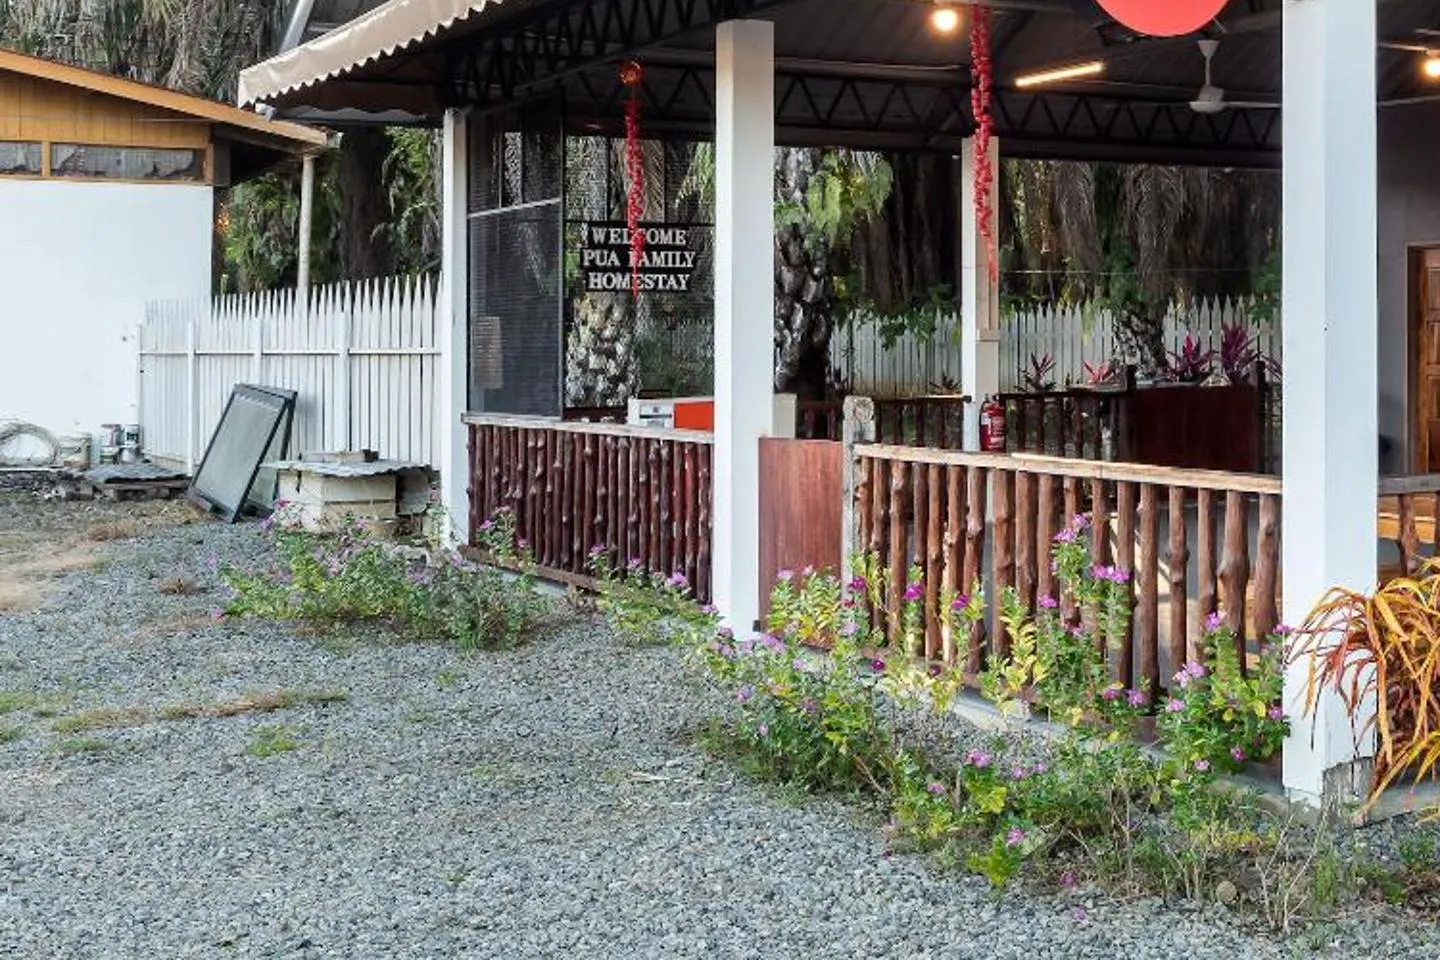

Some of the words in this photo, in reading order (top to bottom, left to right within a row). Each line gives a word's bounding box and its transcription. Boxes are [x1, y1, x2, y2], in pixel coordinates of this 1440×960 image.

[591, 227, 687, 245] WELOME
[583, 248, 620, 267] PUA
[588, 272, 690, 291] HOMESTAY
